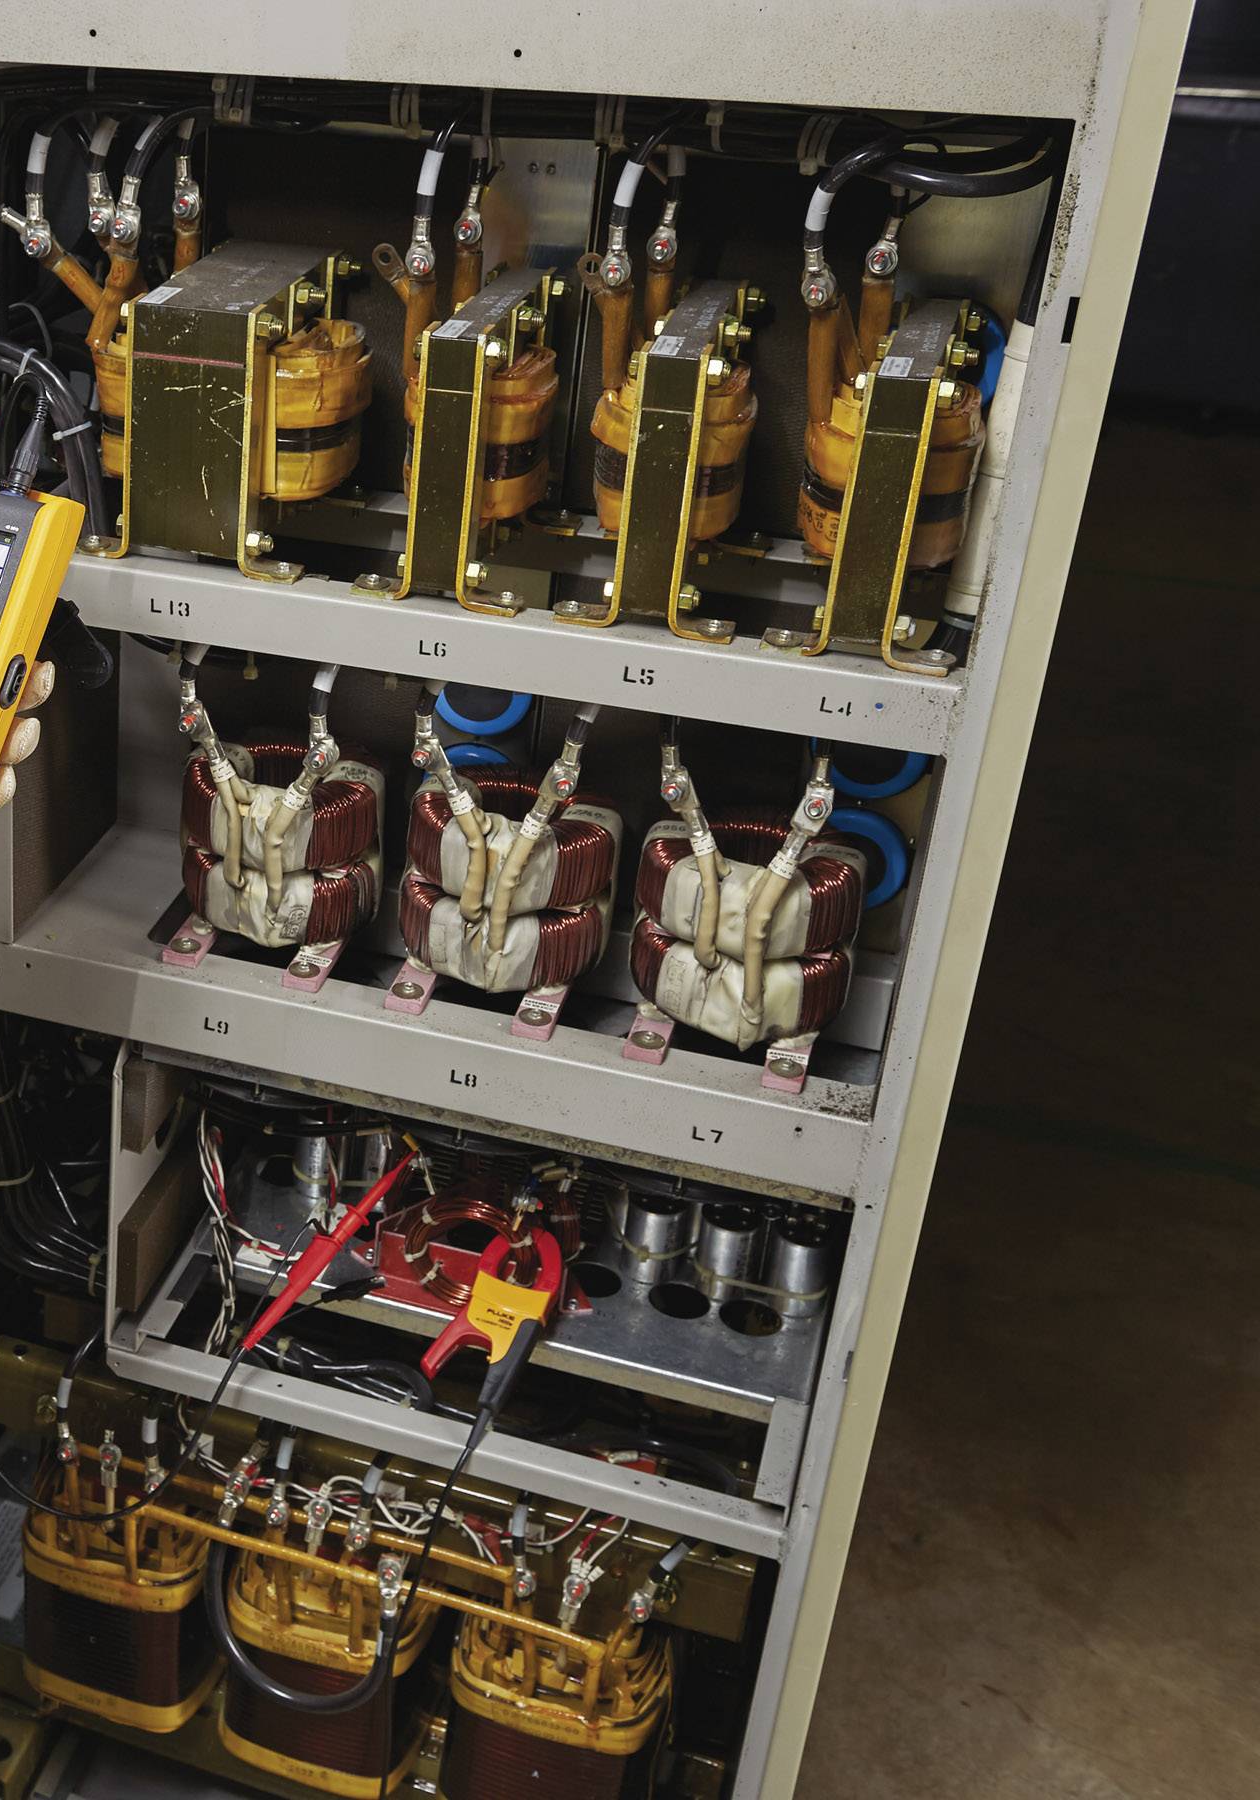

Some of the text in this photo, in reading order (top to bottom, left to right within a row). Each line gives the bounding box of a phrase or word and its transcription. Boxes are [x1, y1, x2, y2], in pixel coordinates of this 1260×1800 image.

[419, 639, 448, 657] L6
[623, 665, 655, 686] L5
[819, 696, 853, 718] L4
[204, 1017, 229, 1035] L9
[450, 1069, 477, 1088] L8
[691, 1126, 723, 1144] L7
[487, 1308, 515, 1321] FLUKE
